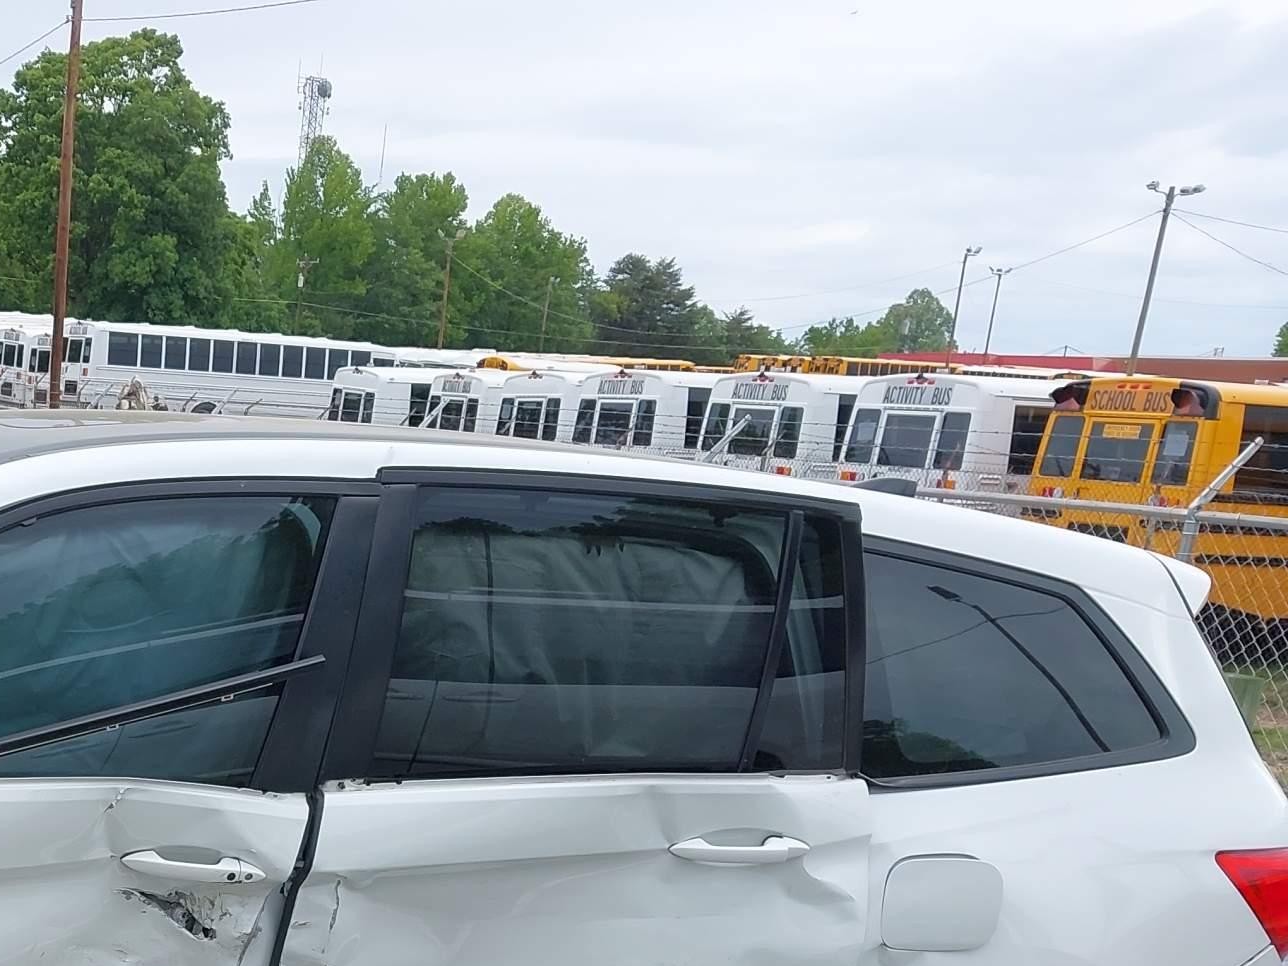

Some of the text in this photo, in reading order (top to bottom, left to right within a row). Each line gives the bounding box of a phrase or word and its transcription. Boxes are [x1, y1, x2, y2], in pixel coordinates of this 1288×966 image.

[598, 380, 644, 395] ACTIVITY BUS
[732, 383, 789, 401] ACTIVITY BUS
[882, 386, 953, 406] ACTIVITY BUS
[1091, 390, 1170, 412] SCHOOL BUS
